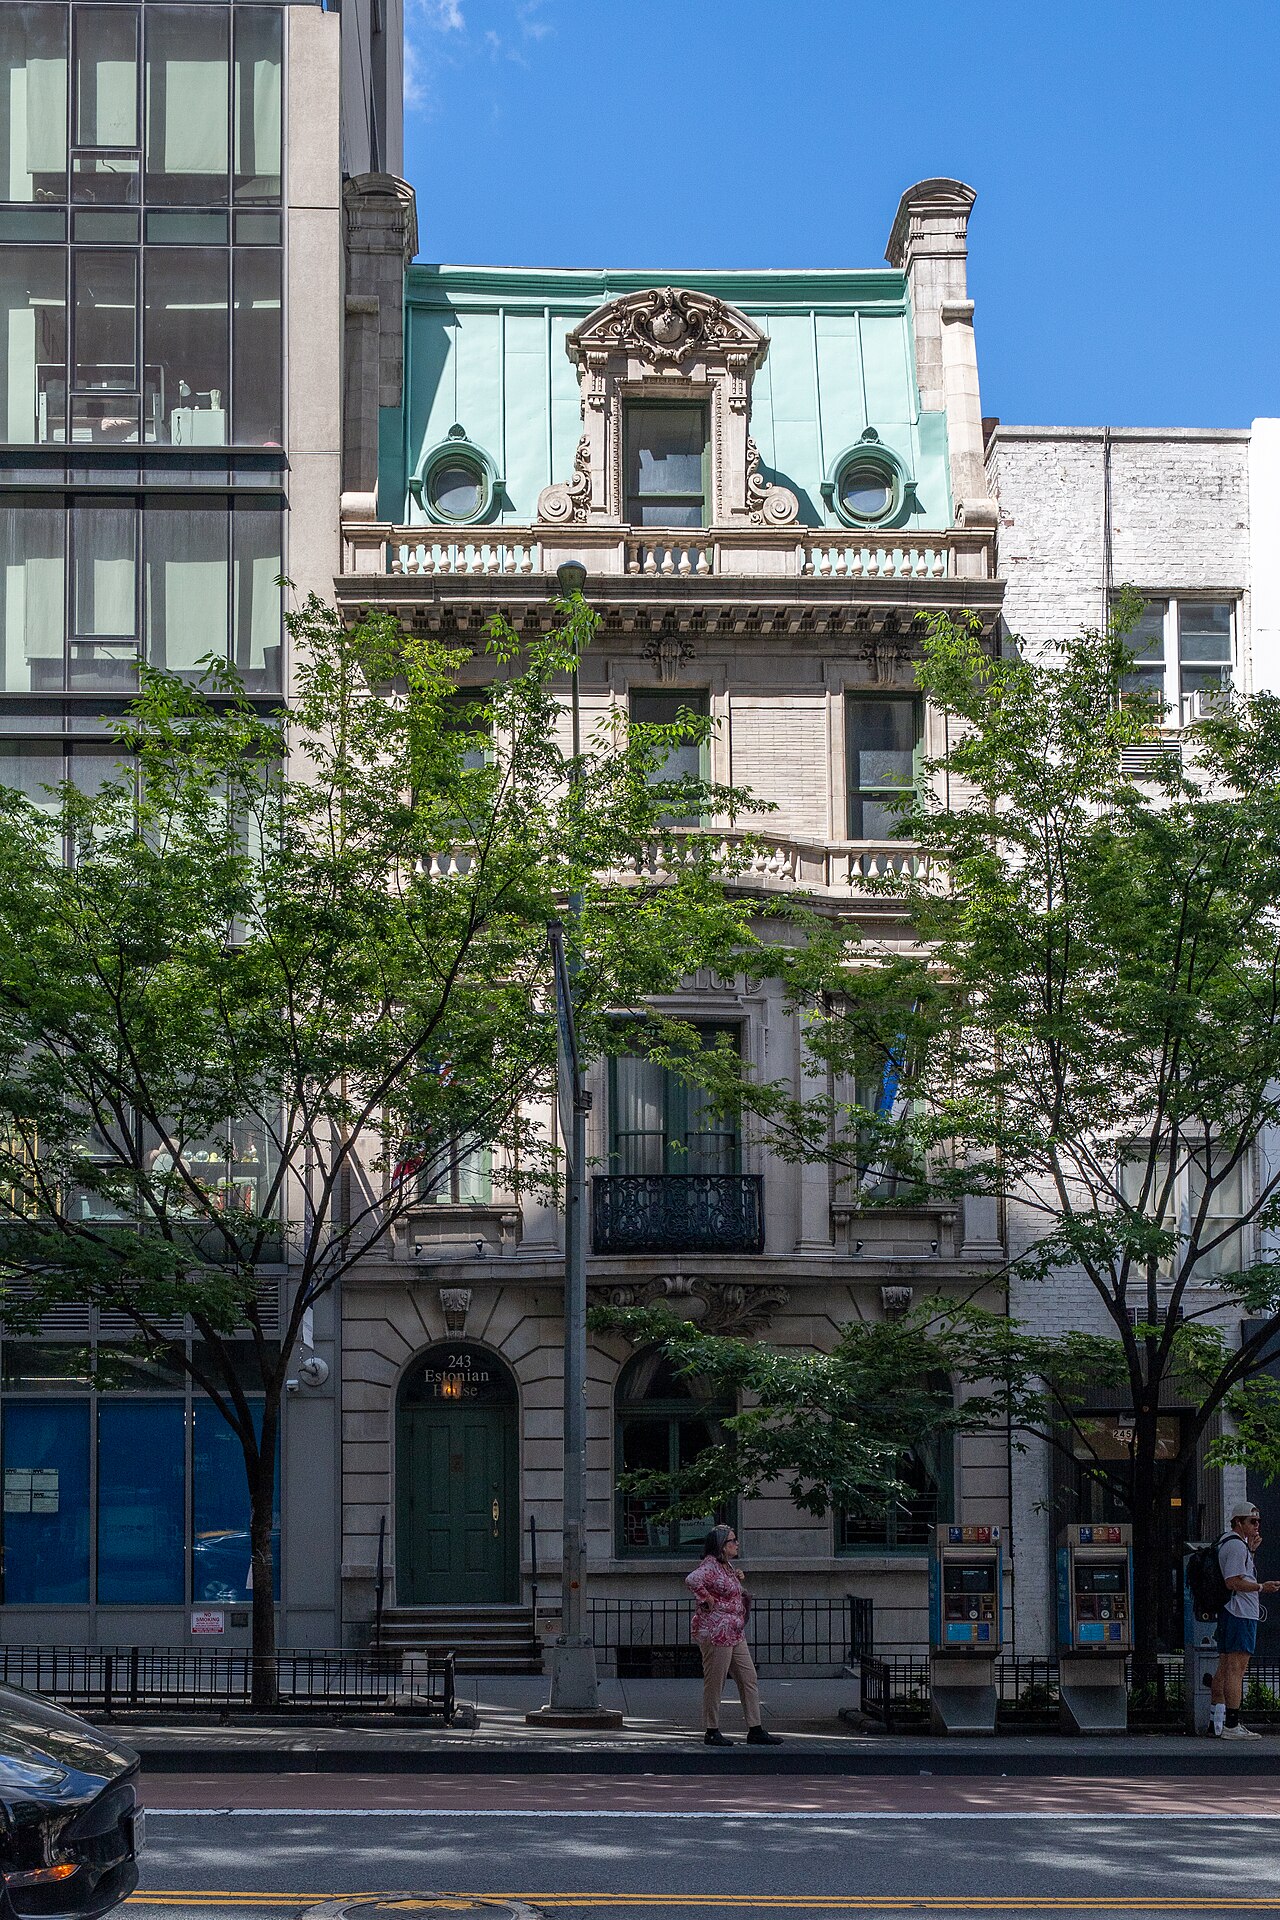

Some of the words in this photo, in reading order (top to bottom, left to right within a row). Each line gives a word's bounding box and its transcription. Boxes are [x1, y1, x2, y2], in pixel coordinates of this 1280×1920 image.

[680, 966, 737, 990] CLUB
[448, 1355, 471, 1368] 243
[424, 1369, 489, 1382] Estonian
[433, 1384, 478, 1397] Hse
[1113, 1430, 1132, 1438] 245
